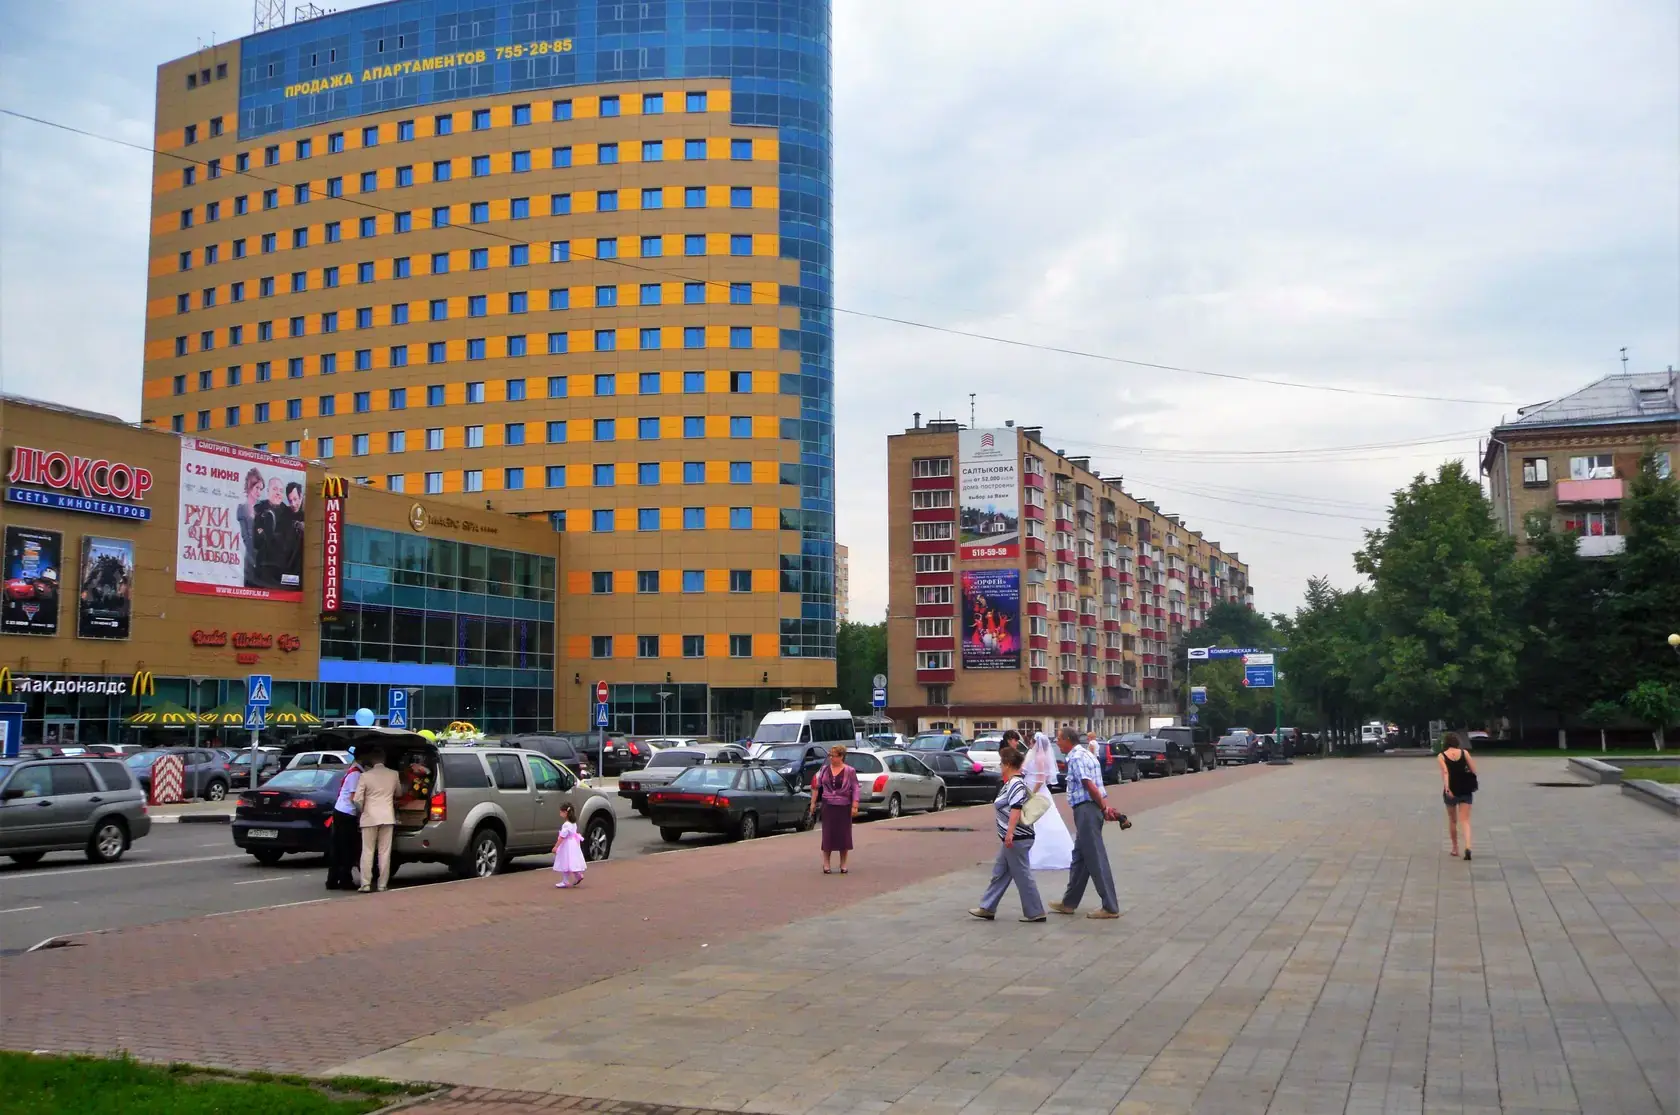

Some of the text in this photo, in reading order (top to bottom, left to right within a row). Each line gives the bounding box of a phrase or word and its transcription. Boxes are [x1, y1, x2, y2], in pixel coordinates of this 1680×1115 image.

[285, 38, 573, 98] ПРОДАЖА АПАРТАМЕНТОВ 755-28-85
[198, 441, 231, 454] СМОТРИТЕ
[7, 446, 153, 500] ЛЮКСОР
[186, 463, 240, 482] С 23 ИЮНЯ
[962, 465, 1014, 475] САЛТЫКОВКА
[16, 490, 146, 518] СЕТЬ КИНОТЕАТРОВ
[184, 504, 230, 528] РУКИ
[197, 527, 241, 551] НОГИ
[198, 547, 241, 566] ЛЮБОВЬ
[326, 499, 340, 610] Макдоналдс
[393, 691, 404, 707] P
